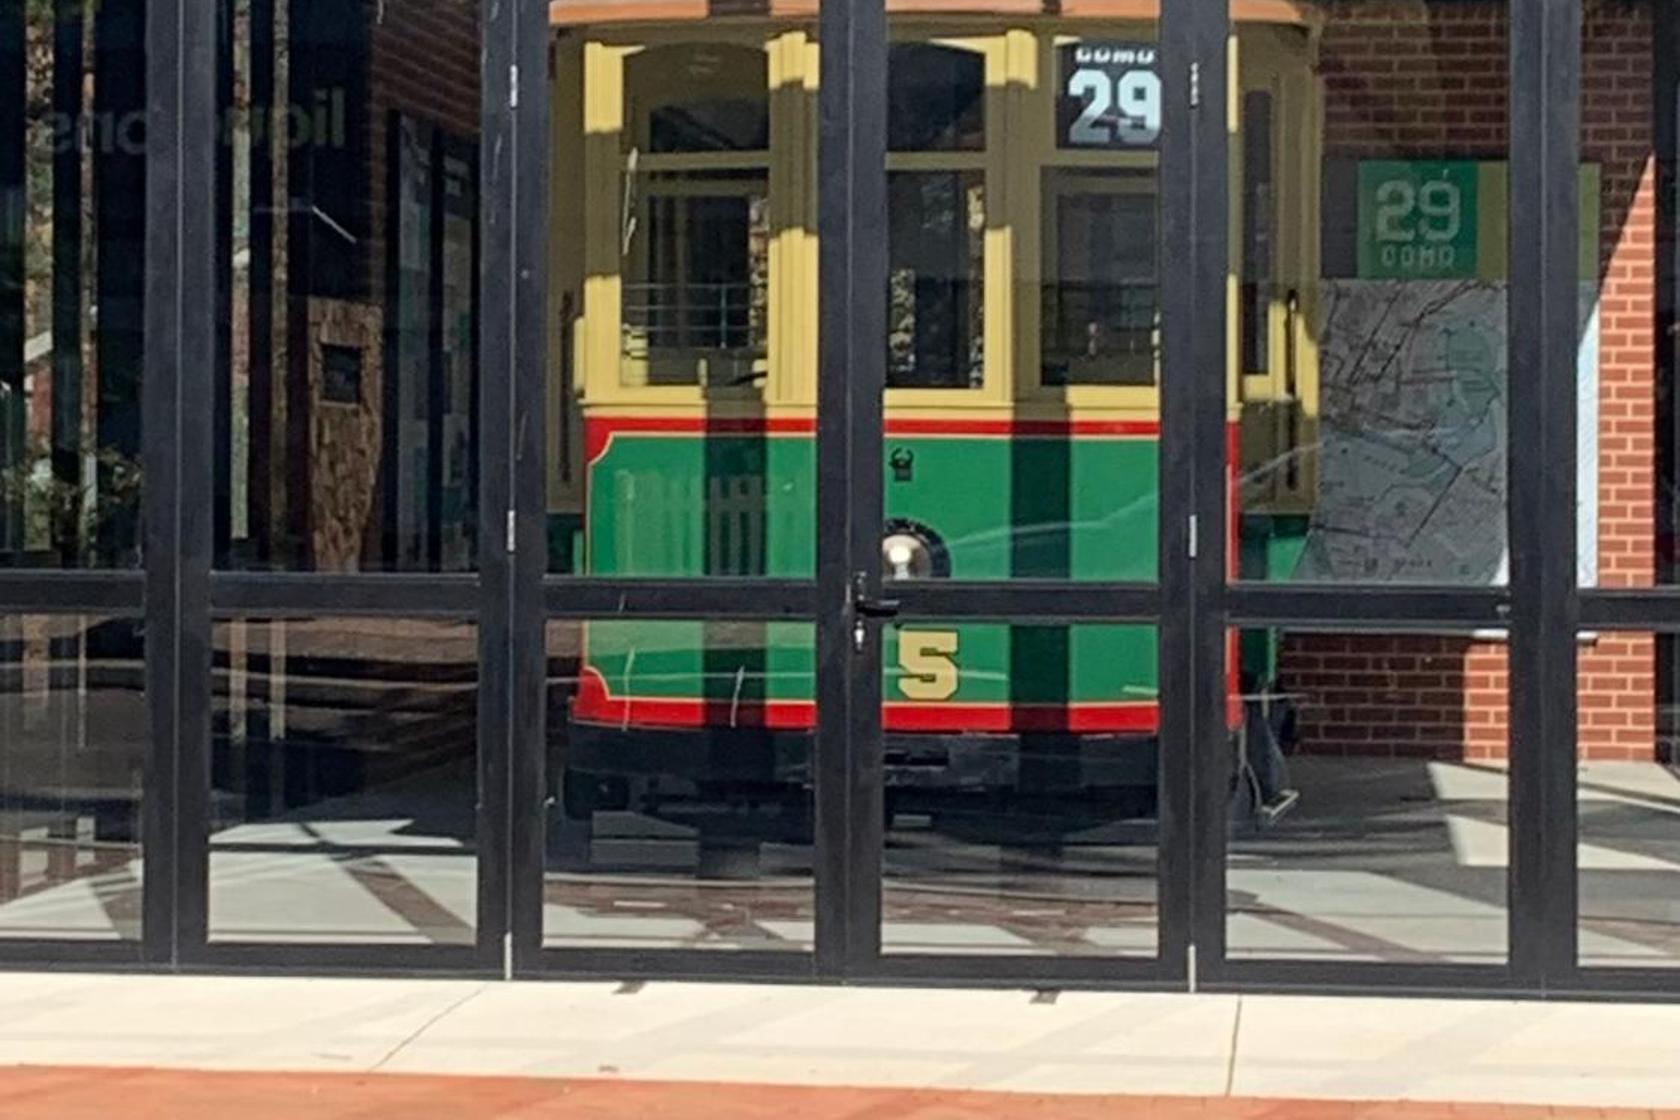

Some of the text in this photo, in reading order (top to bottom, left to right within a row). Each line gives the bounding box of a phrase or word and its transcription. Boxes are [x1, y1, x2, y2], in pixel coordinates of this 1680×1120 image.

[1068, 69, 1162, 145] 29
[1375, 179, 1461, 243] 29
[896, 629, 960, 701] 5
